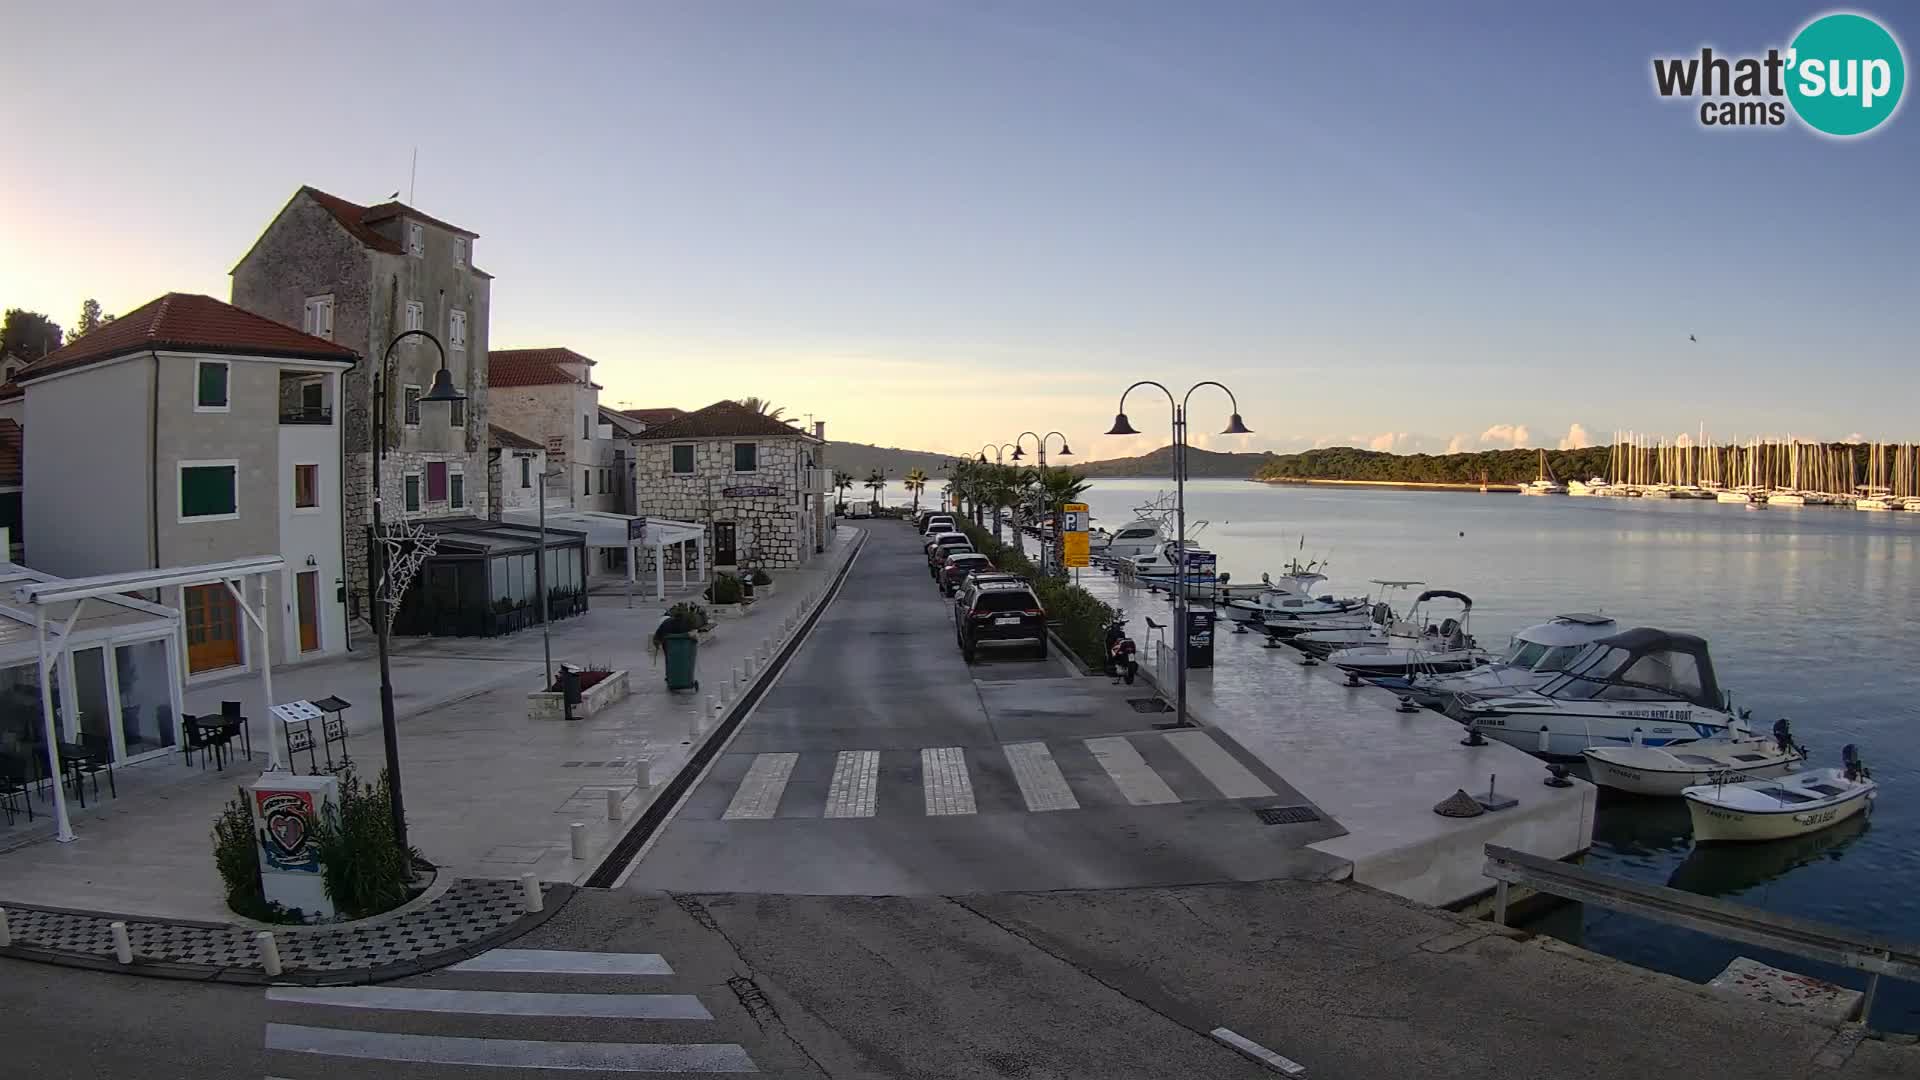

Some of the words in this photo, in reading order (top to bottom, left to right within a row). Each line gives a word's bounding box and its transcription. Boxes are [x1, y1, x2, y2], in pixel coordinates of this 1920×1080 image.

[1065, 514, 1076, 530] P
[1651, 710, 1669, 720] RENT
[1675, 710, 1693, 721] BOAT
